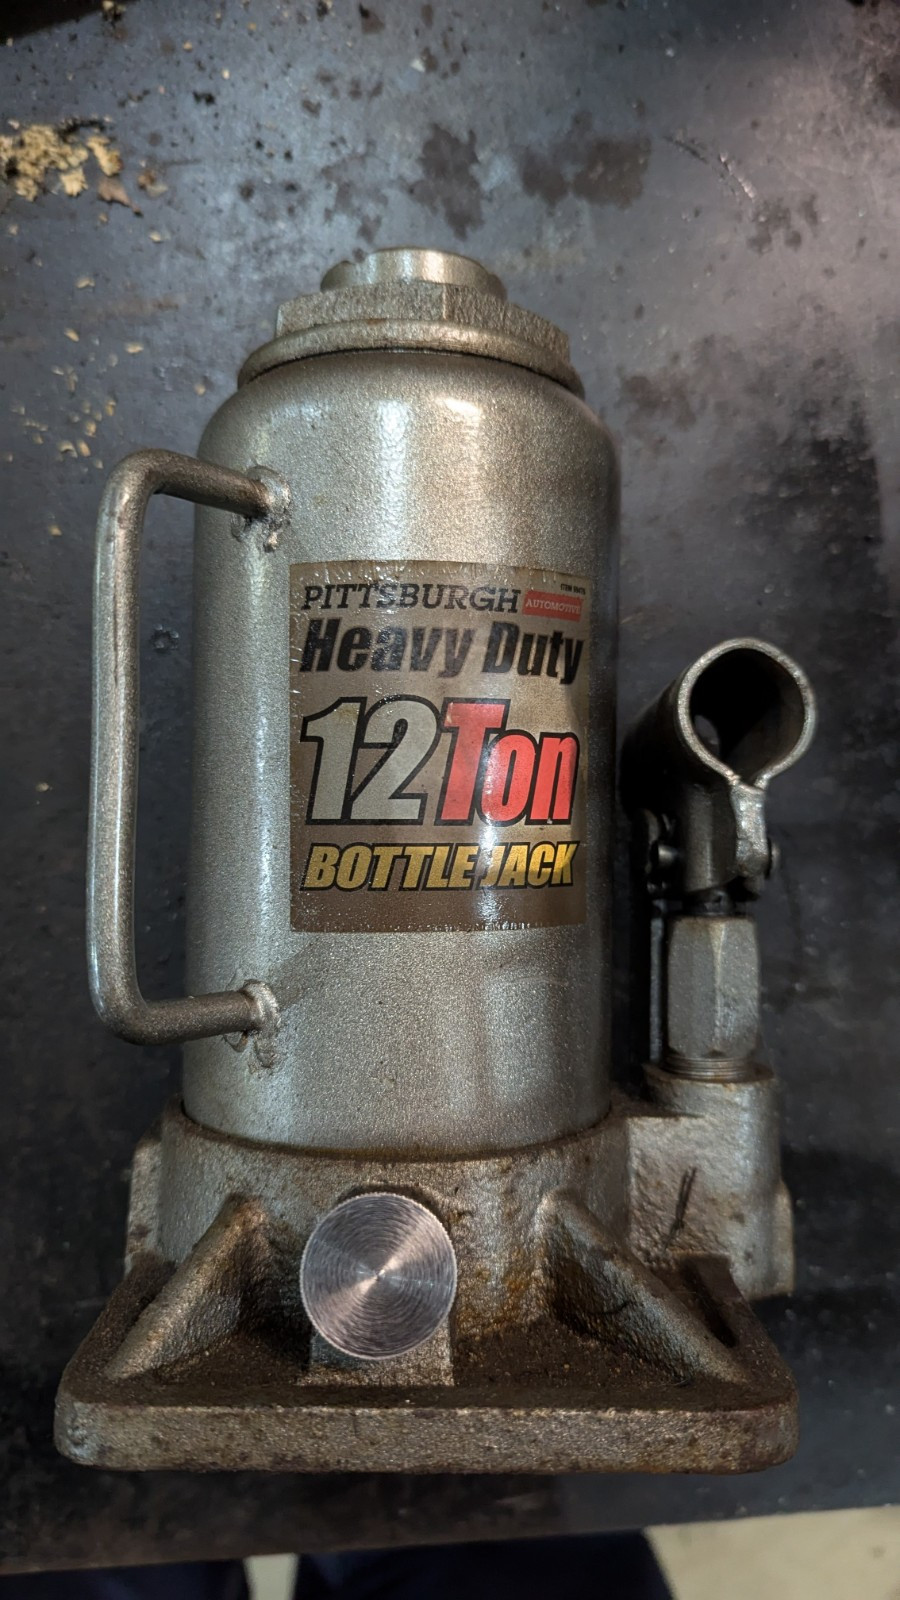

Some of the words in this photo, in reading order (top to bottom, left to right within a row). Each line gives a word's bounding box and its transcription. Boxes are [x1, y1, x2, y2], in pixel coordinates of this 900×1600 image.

[302, 583, 521, 614] PITTSBURGH
[525, 599, 580, 614] AUTOMOTIVE
[300, 618, 476, 678] Heavy
[482, 621, 585, 685] Duty
[300, 695, 442, 826] 12
[434, 697, 581, 827] Ton
[300, 842, 478, 892] BOTTLE
[476, 841, 581, 889] JACK
